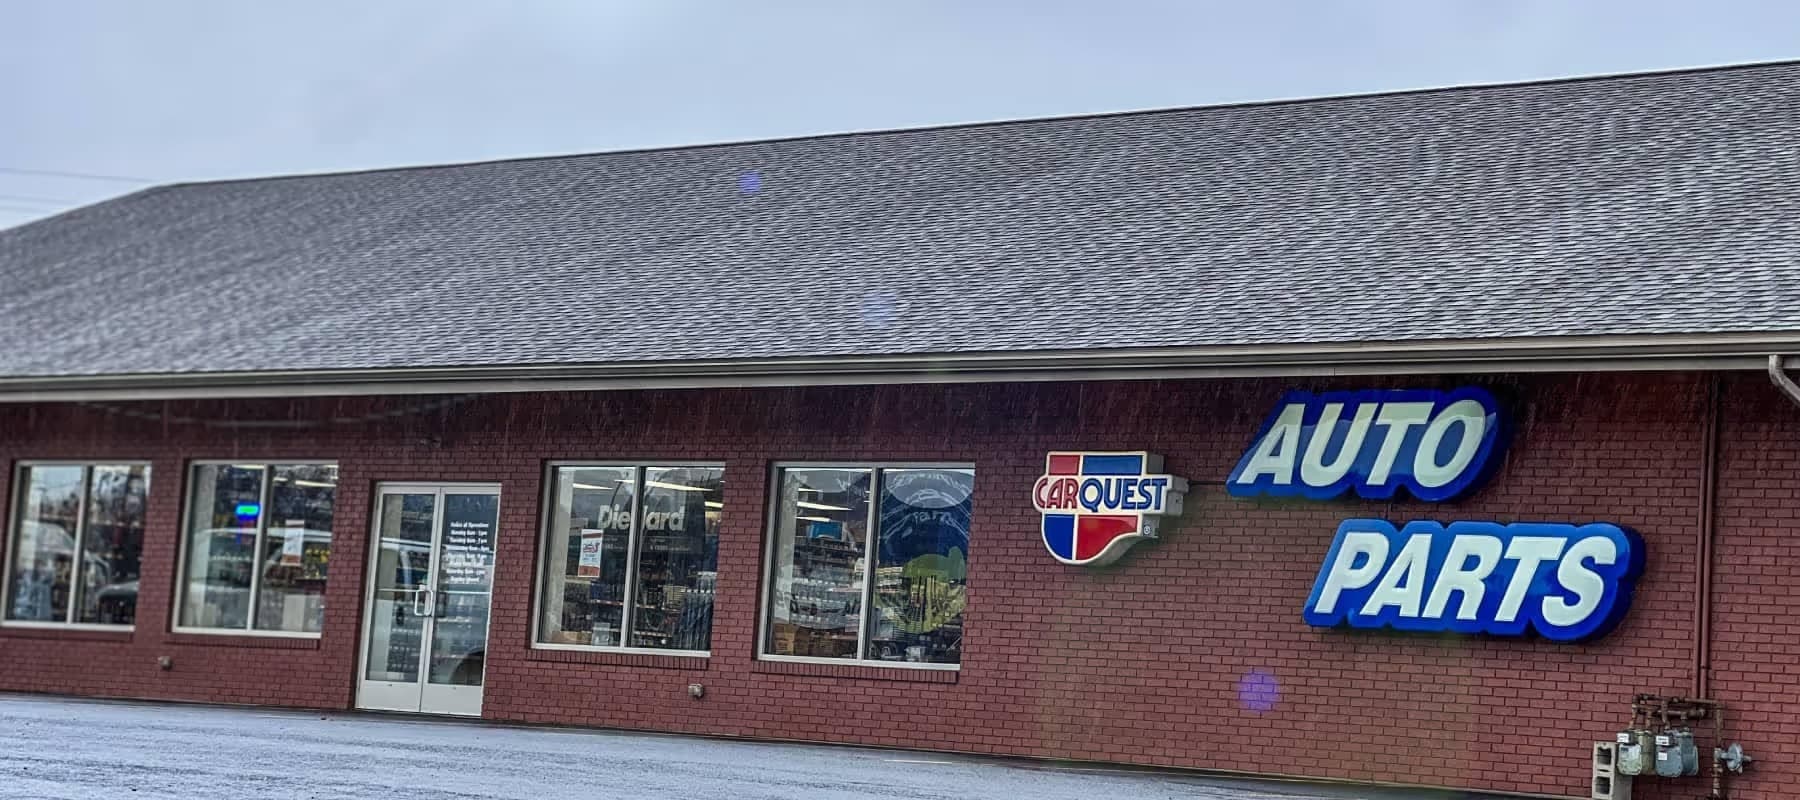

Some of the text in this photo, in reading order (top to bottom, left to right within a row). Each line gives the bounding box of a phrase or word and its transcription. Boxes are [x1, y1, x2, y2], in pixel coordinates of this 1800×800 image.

[1236, 399, 1487, 488] AUTO
[597, 503, 686, 531] Dieard
[1034, 477, 1168, 513] CARQUEST
[1313, 531, 1617, 628] PARTS
